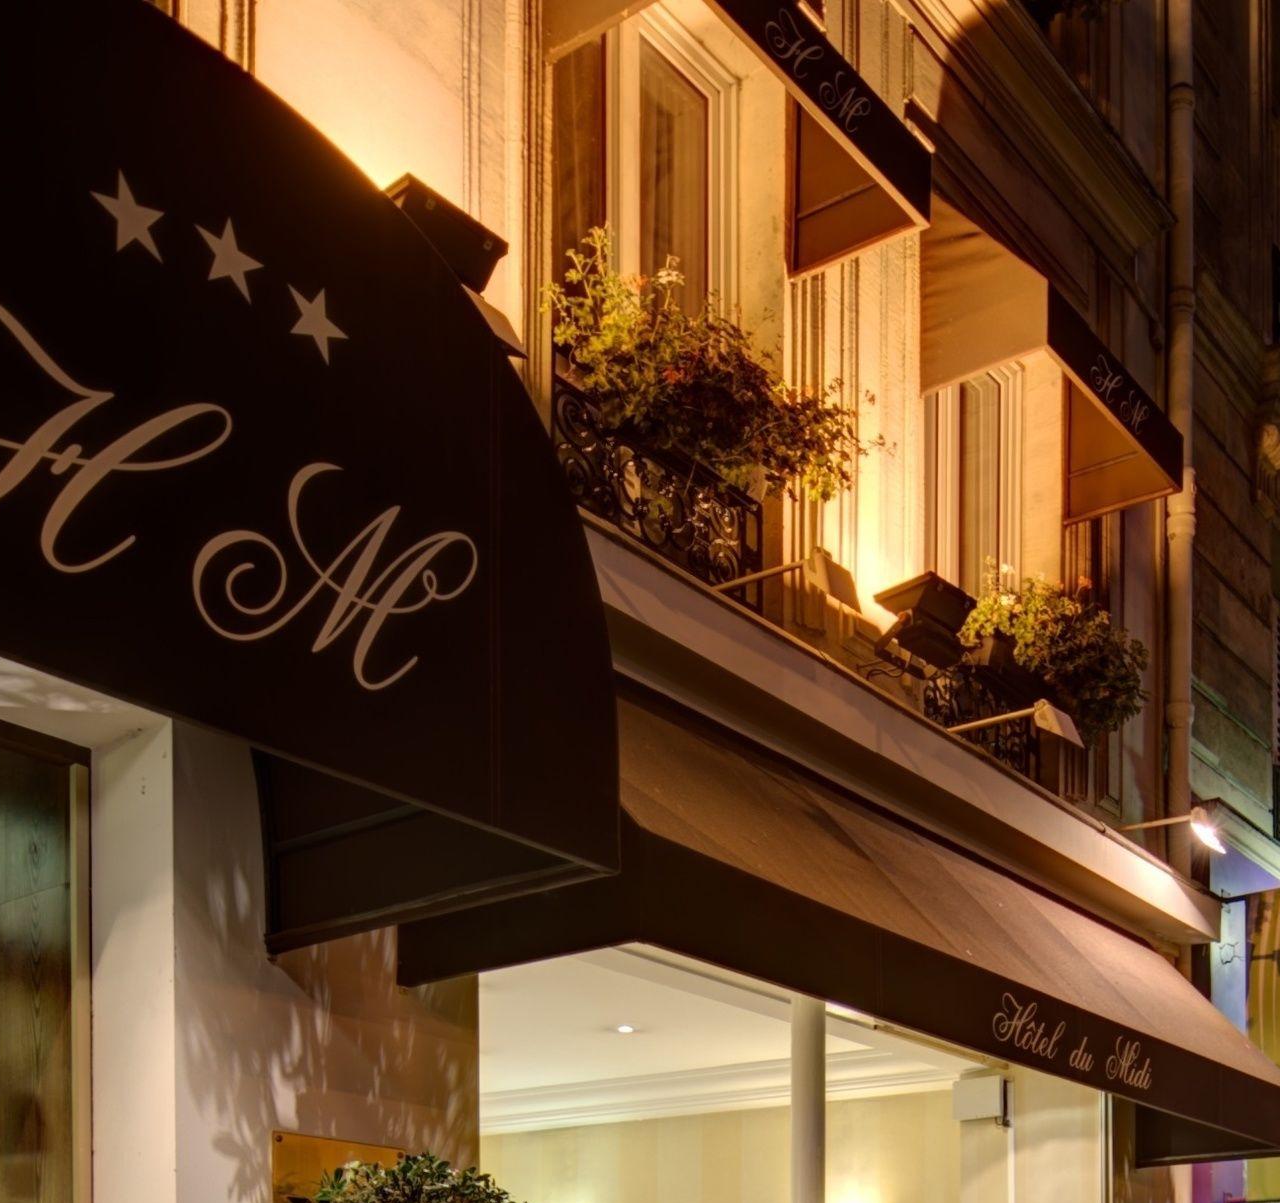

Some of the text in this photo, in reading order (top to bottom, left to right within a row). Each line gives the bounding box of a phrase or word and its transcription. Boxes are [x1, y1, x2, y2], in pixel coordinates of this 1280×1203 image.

[192, 461, 478, 691] M
[992, 992, 1153, 1091] Hôtel du Midi
